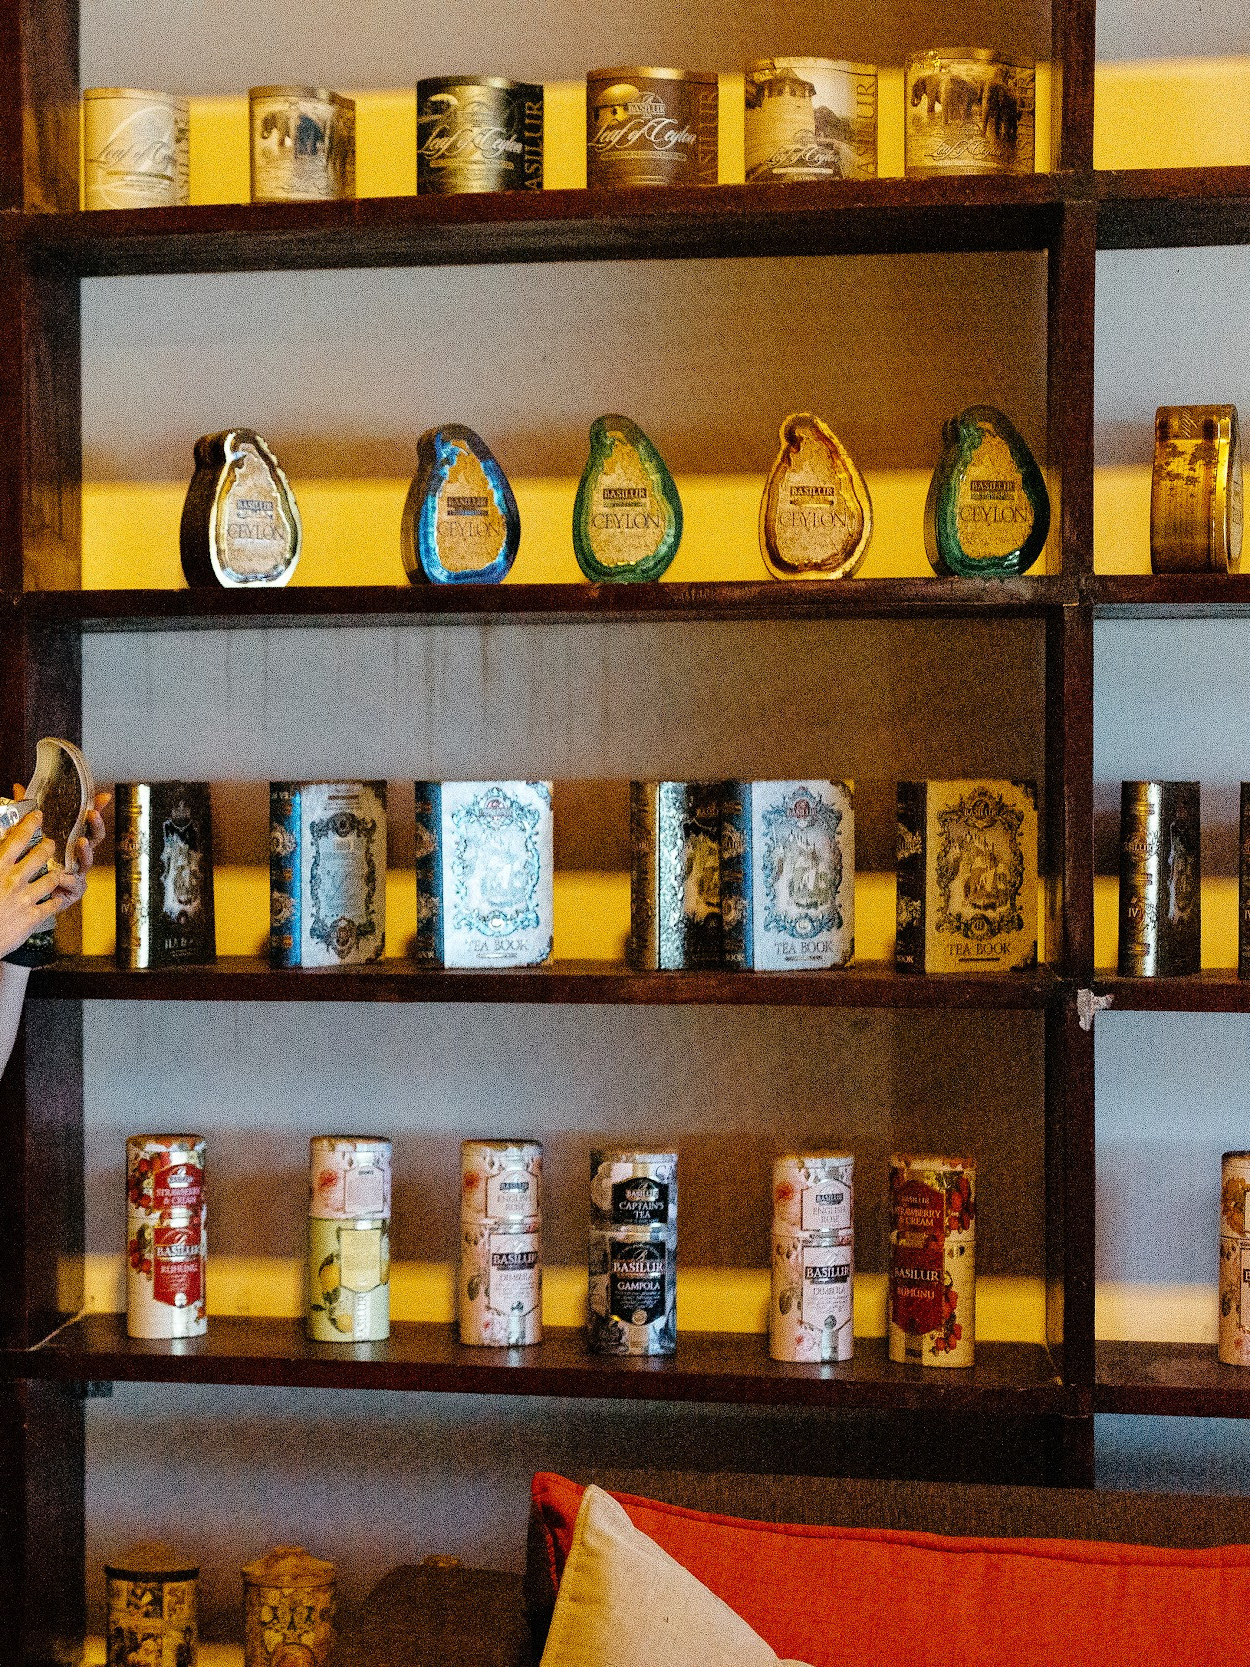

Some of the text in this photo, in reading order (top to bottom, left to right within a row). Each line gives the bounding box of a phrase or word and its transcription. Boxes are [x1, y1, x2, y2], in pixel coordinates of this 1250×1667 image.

[588, 119, 644, 152] Leaf
[645, 118, 697, 150] Ceylon
[856, 80, 876, 177] ASILUR
[699, 91, 718, 183] ASILUR
[525, 100, 543, 191] ASILUR
[592, 514, 660, 530] CEYLON
[959, 506, 1027, 523] CEYLON
[801, 941, 833, 954] BOOK
[975, 943, 1011, 955] BOOK
[634, 1210, 652, 1219] TEA
[613, 1262, 664, 1272] BASILUR
